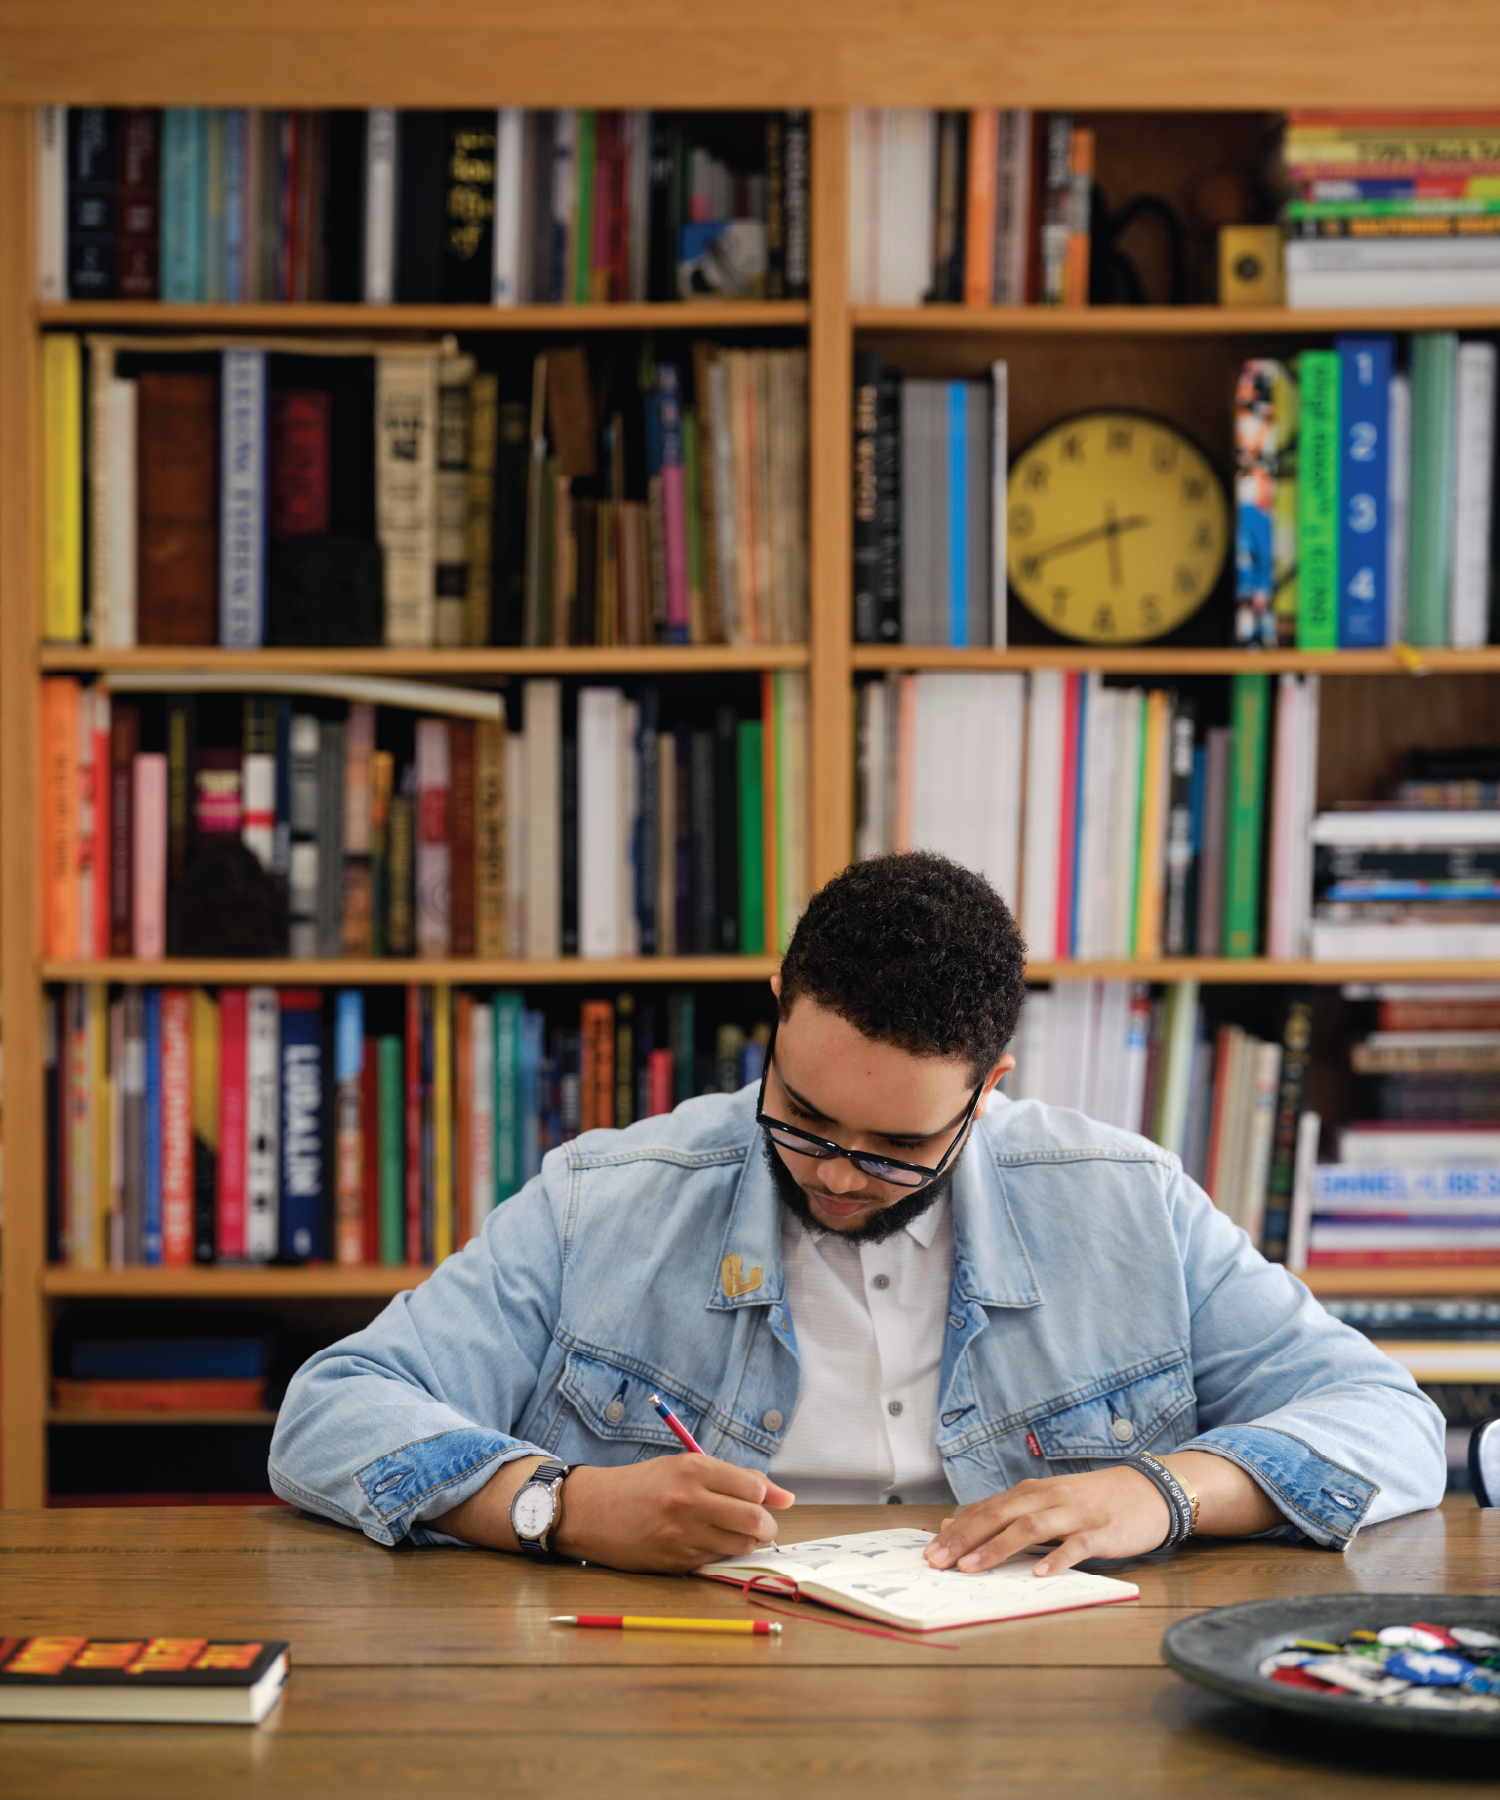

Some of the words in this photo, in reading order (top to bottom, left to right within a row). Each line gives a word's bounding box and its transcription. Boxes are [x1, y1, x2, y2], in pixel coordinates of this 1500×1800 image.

[1356, 350, 1374, 387] 1
[1349, 421, 1377, 461] 2
[1348, 493, 1377, 533] 3
[1348, 566, 1376, 602] 4
[283, 1043, 322, 1196] LUBALIN
[1140, 1455, 1162, 1472] Unite
[1160, 1469, 1171, 1481] To
[1169, 1480, 1188, 1507] Fight
